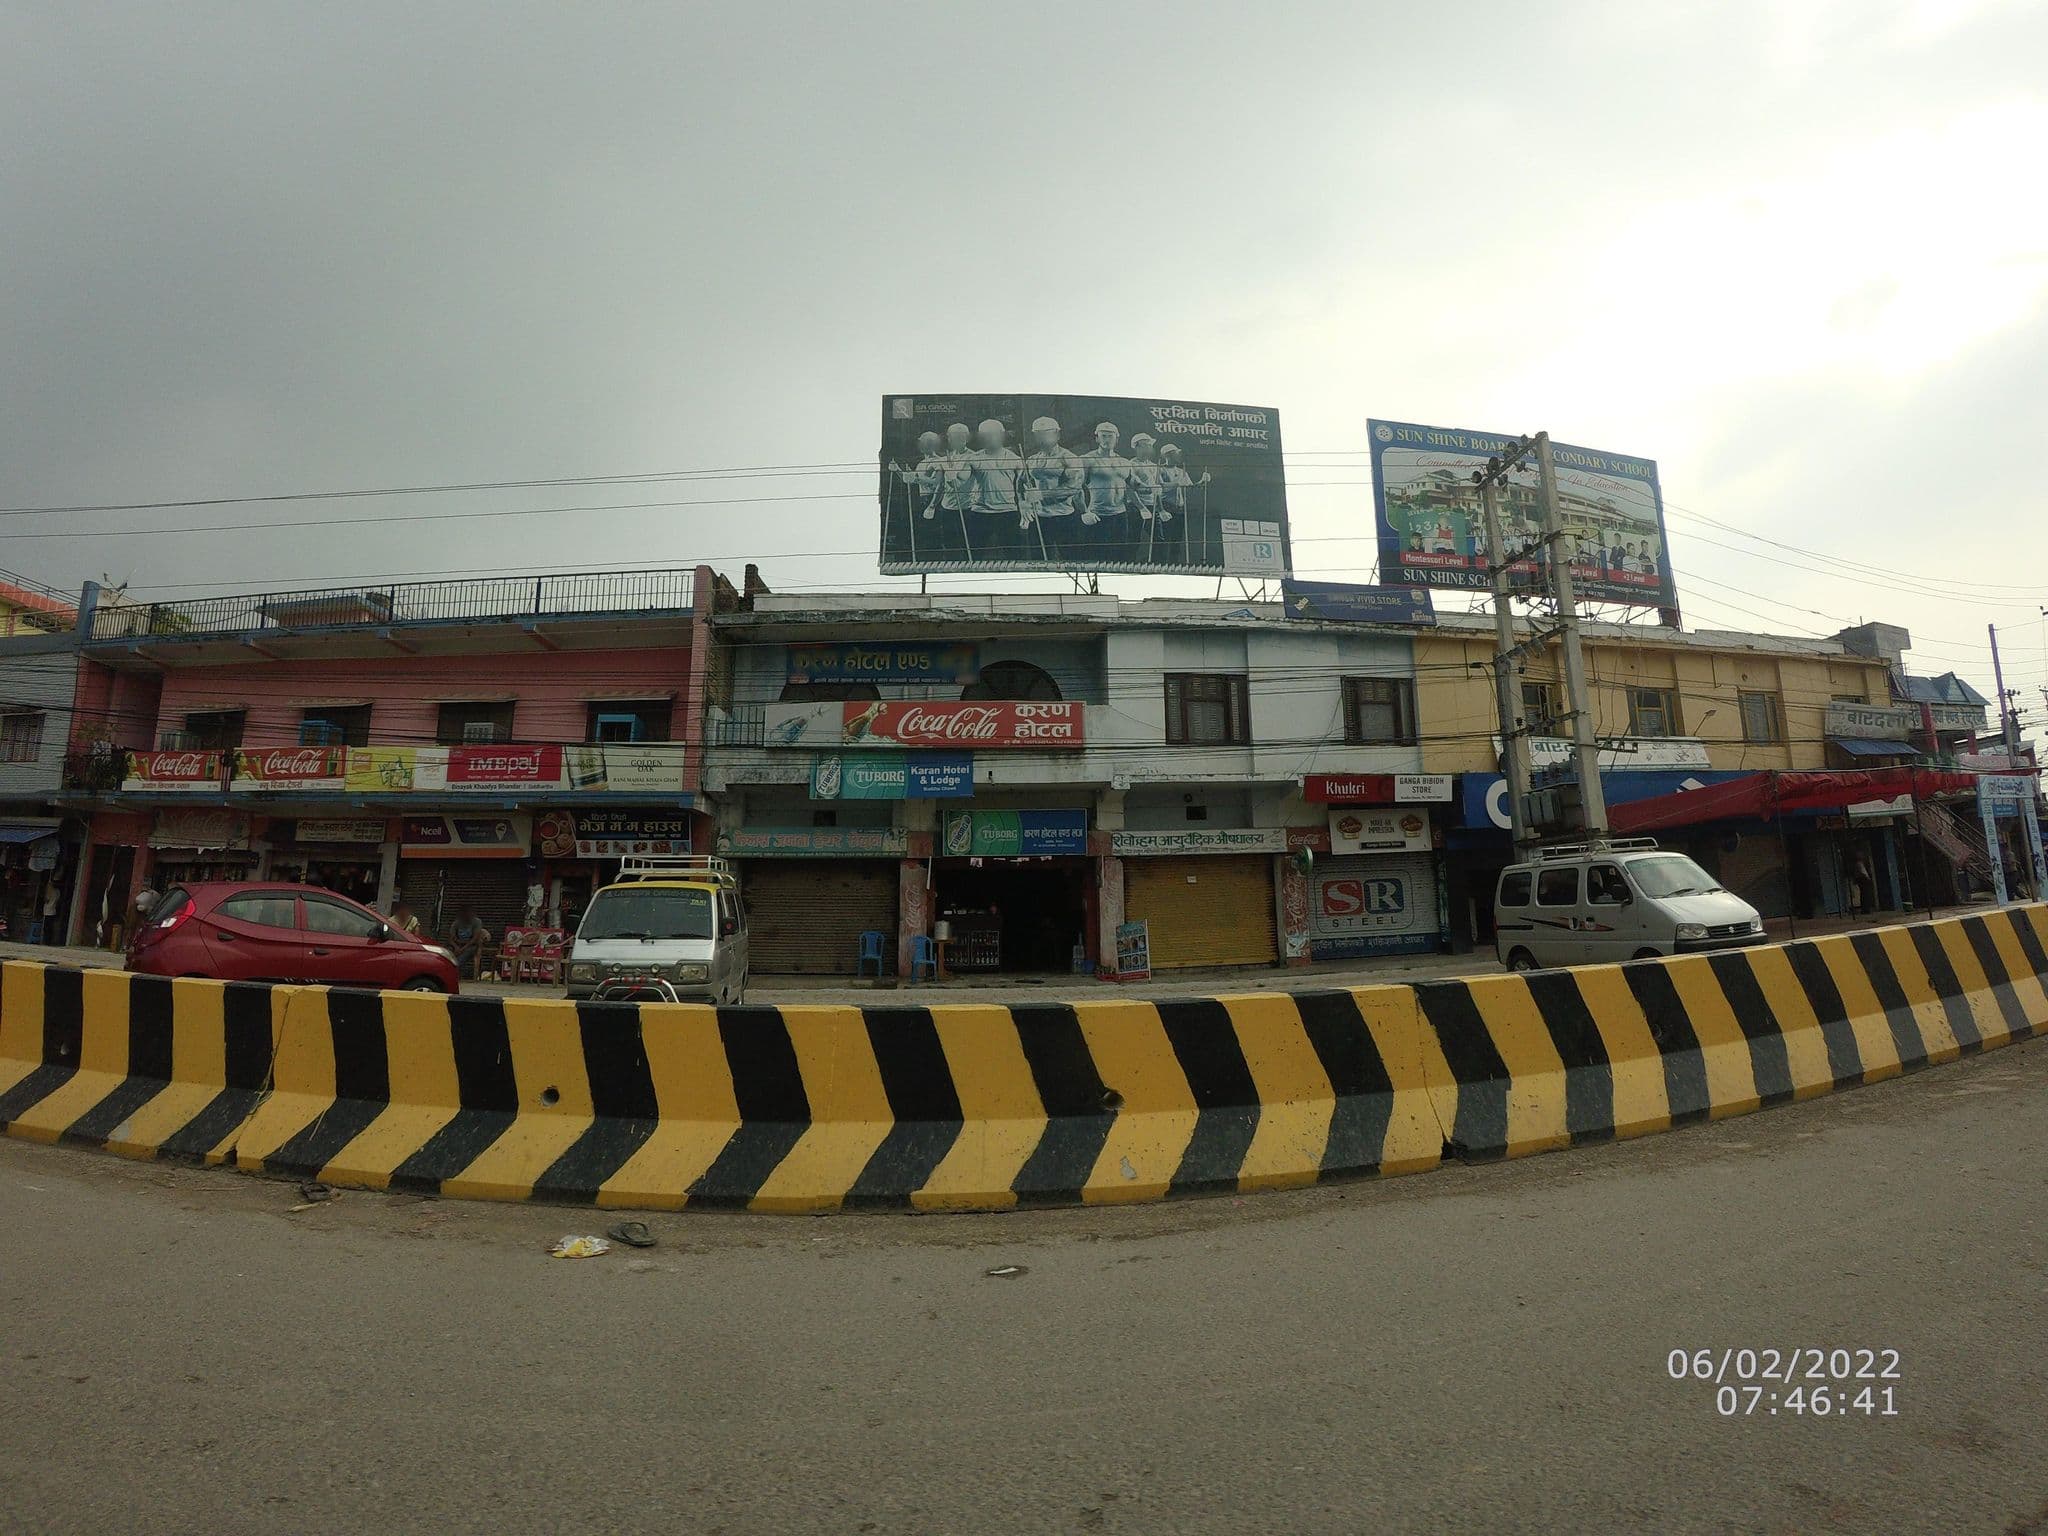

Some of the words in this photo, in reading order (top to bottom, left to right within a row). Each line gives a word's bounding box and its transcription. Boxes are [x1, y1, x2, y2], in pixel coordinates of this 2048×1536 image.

[1149, 404, 1201, 420] सुरक्षित
[1204, 407, 1267, 425] निर्माणको
[1227, 427, 1269, 440] आधार
[1397, 428, 1423, 442] SUN
[1427, 433, 1467, 448] SHINE
[1611, 459, 1655, 478] SCHOOL
[1405, 553, 1444, 564] Montessori
[1446, 556, 1464, 566] Level
[1403, 568, 1428, 582] SUN
[1430, 571, 1466, 586] SHINE
[1015, 703, 1072, 718] करण
[897, 707, 1003, 739] Coca-Cola
[1014, 719, 1072, 737] होटल
[152, 753, 205, 776] Coca-Cola
[264, 750, 325, 775] Coca-Cola
[630, 759, 663, 767] GOLDEN
[910, 765, 942, 775] Karan
[943, 764, 970, 774] Hotel
[818, 763, 841, 793] TUBORG
[856, 770, 904, 783] TUBORG
[919, 776, 928, 785] &
[930, 775, 961, 786] Lodge
[1399, 777, 1421, 785] GANGA
[1325, 780, 1365, 795] Khukri
[1411, 786, 1432, 794] STORE
[421, 826, 442, 836] Ncell
[982, 829, 1018, 839] TUBORG
[1326, 881, 1401, 914] SR
[1332, 917, 1398, 928] STEEL
